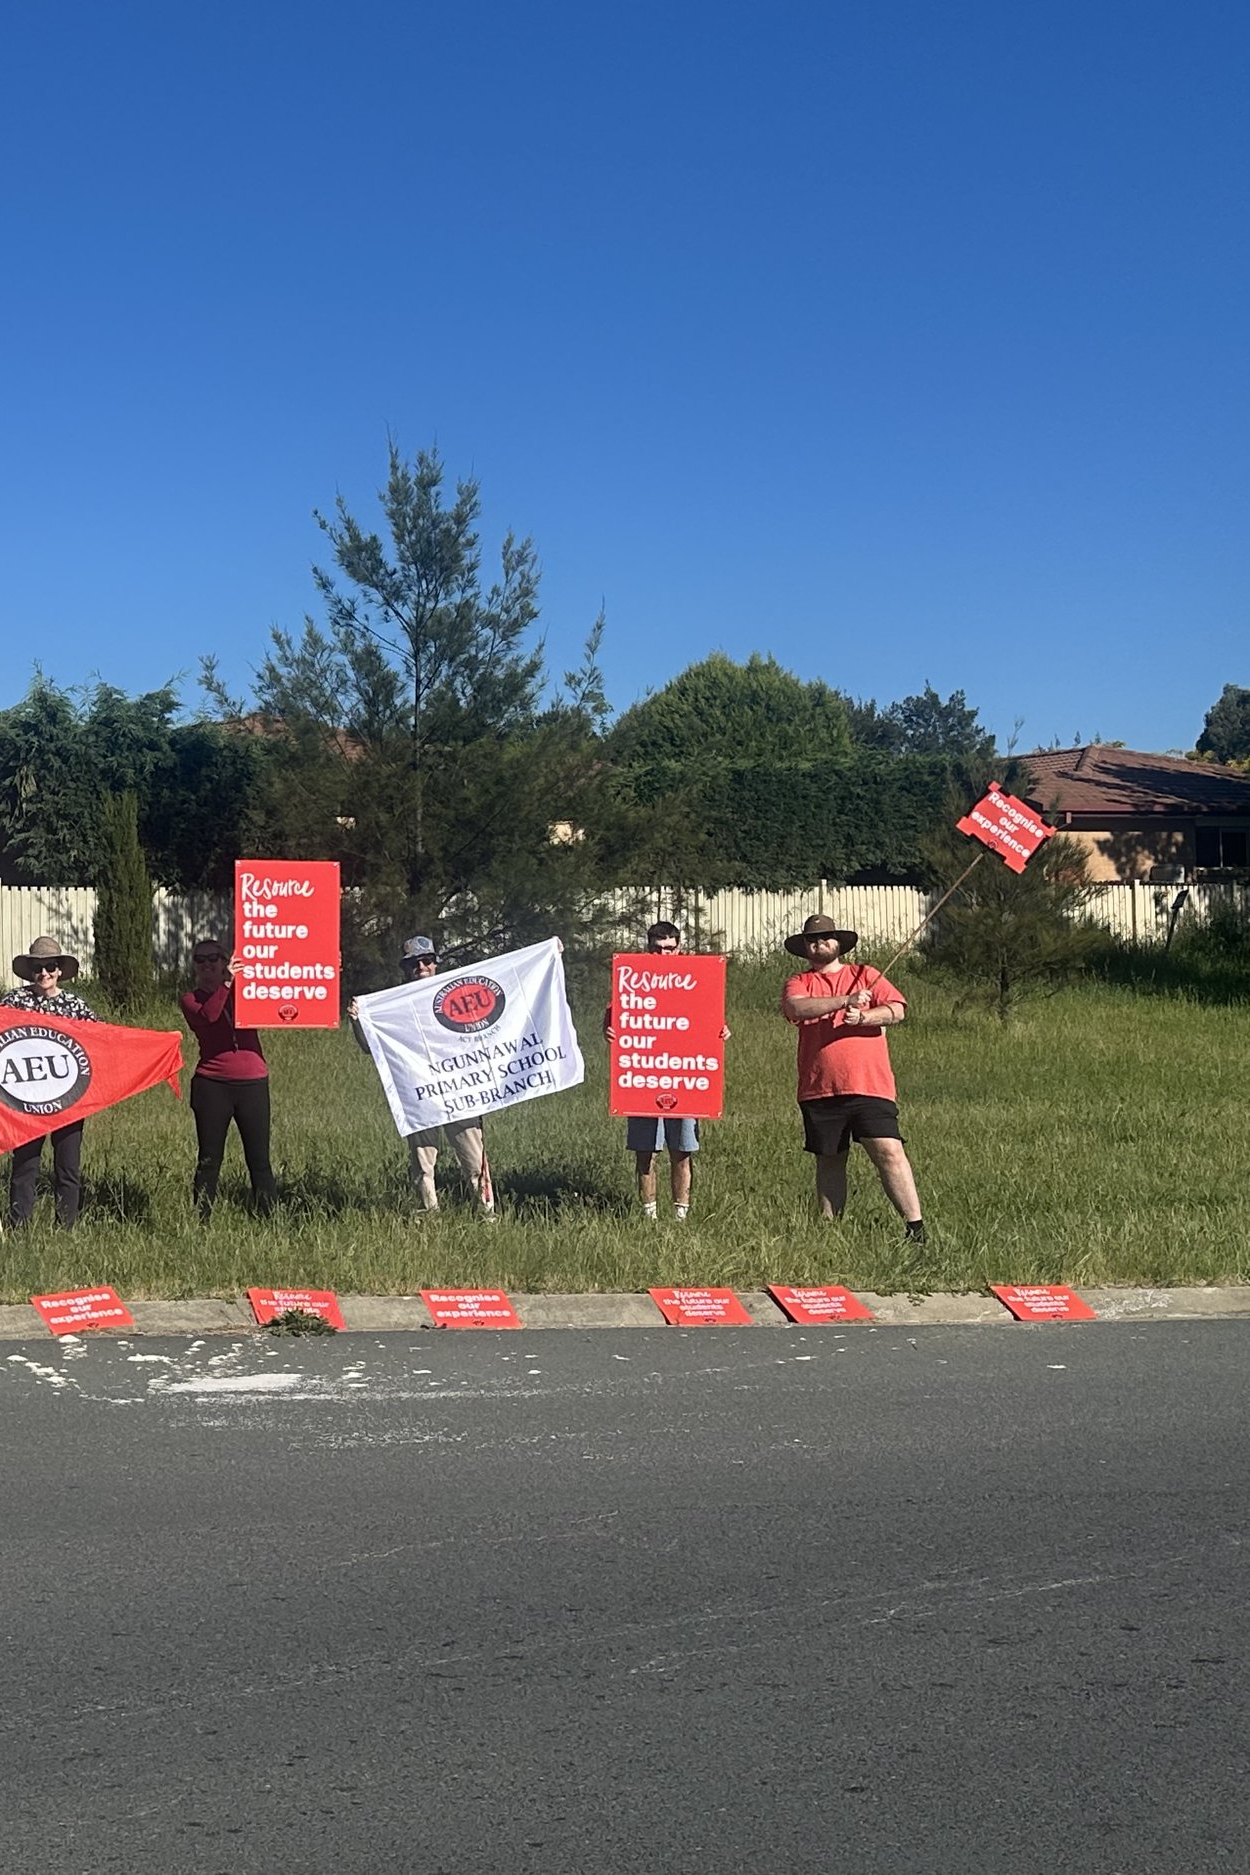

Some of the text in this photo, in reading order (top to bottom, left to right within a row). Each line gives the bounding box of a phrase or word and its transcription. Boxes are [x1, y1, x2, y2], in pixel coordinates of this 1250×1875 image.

[988, 791, 1043, 837] Recognise
[999, 817, 1019, 833] our
[971, 812, 1030, 857] experience
[240, 873, 314, 901] Resource
[243, 901, 277, 918] the
[243, 921, 308, 938] future
[243, 945, 278, 958] our
[243, 962, 335, 979] students
[617, 966, 697, 993] Resource
[243, 982, 327, 1000] deserve
[450, 989, 491, 1017] AEU
[620, 993, 656, 1010] the
[619, 1012, 690, 1030] future
[619, 1034, 656, 1049] our
[30, 1026, 91, 1076] EDUCATION
[428, 1033, 543, 1076] NGUNNAWAL
[2, 1054, 70, 1084] AEU
[618, 1052, 719, 1071] students
[415, 1046, 566, 1100] PRIMARY SCHOOL
[618, 1071, 709, 1090] deserve
[444, 1070, 553, 1114] SUB-BRANCH
[23, 1100, 63, 1114] UNION
[41, 1293, 110, 1308] Recognise
[430, 1294, 500, 1302] Recognise
[50, 1308, 123, 1324] experience
[70, 1305, 92, 1313] our
[437, 1310, 510, 1318] experience
